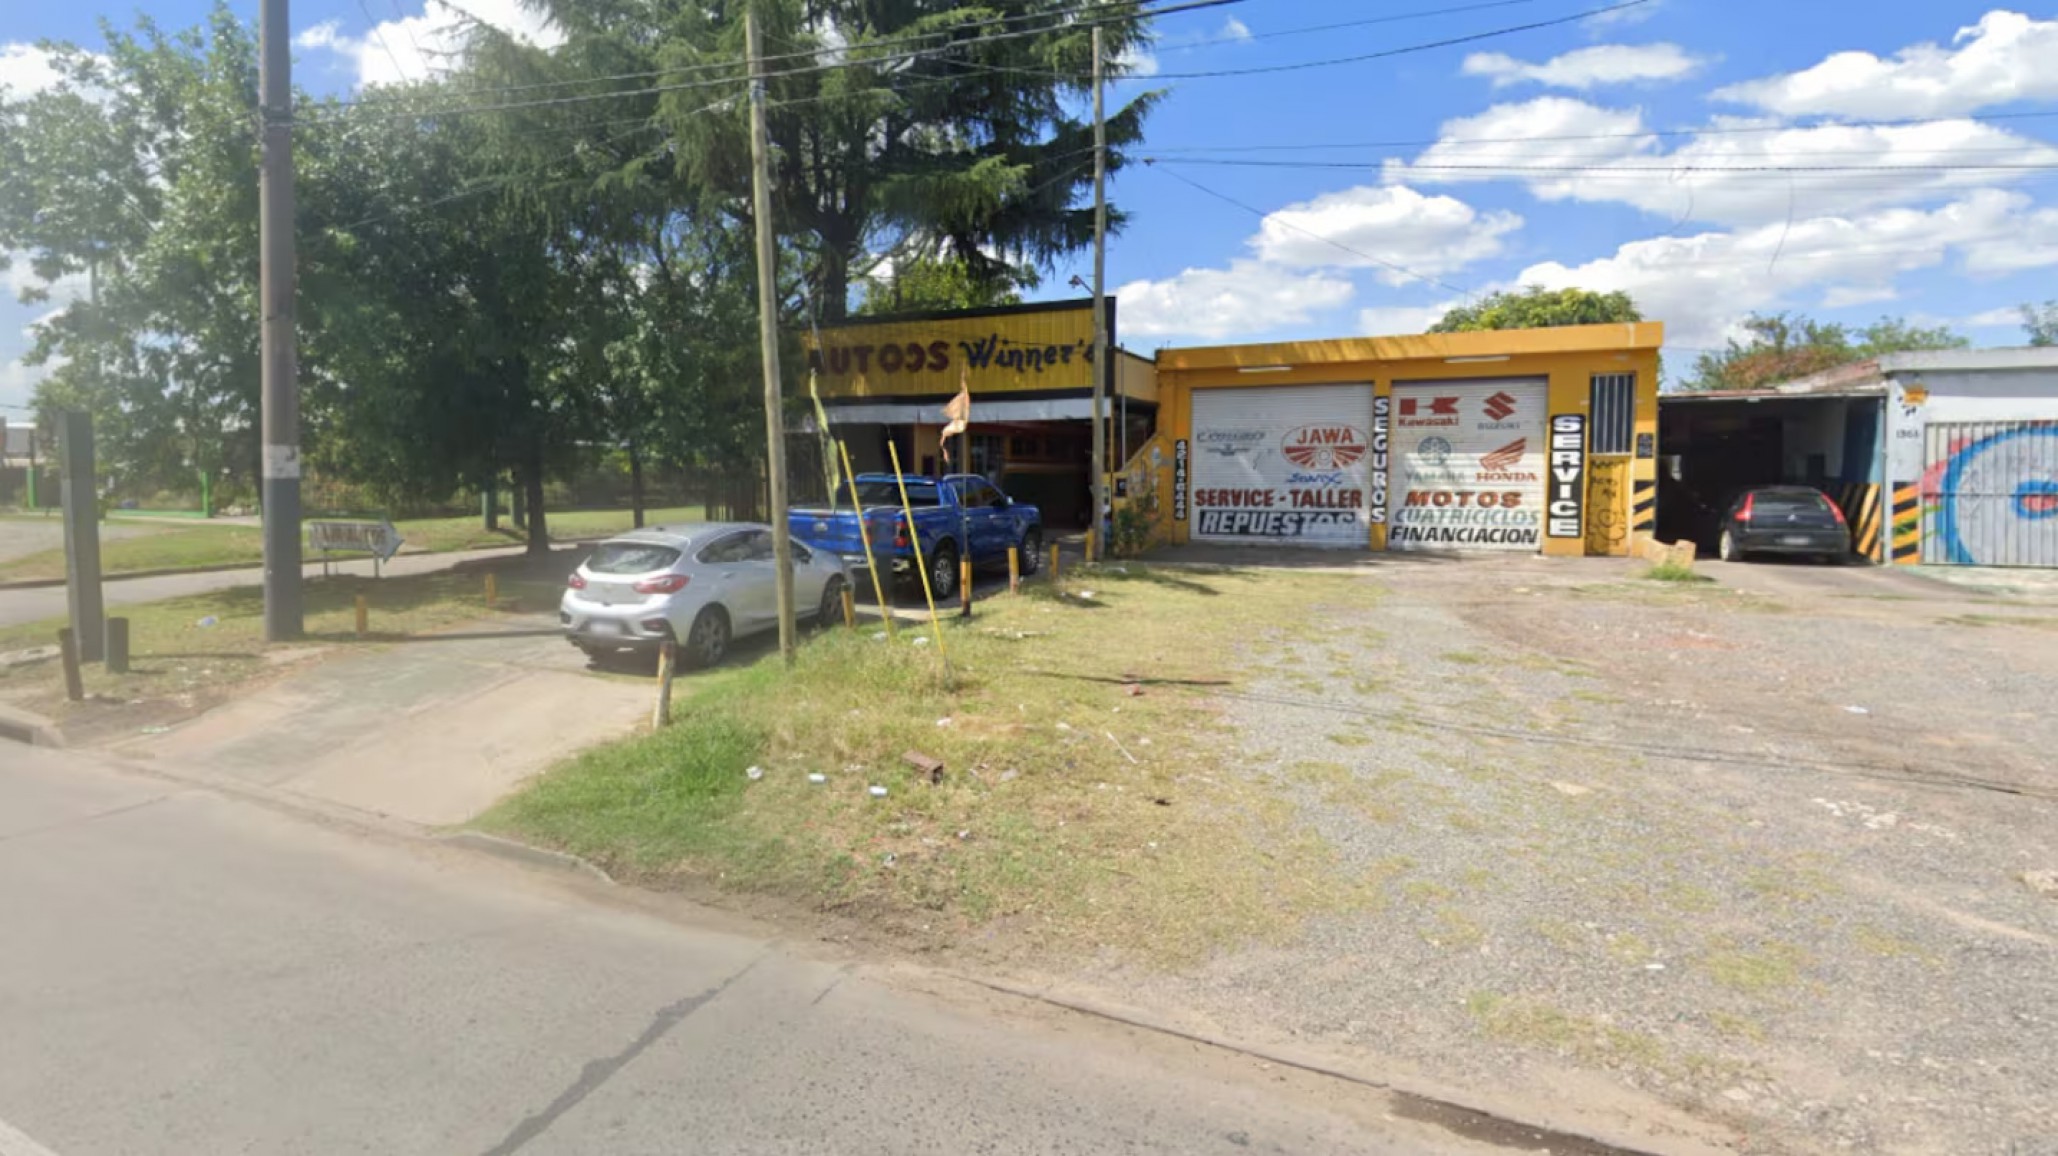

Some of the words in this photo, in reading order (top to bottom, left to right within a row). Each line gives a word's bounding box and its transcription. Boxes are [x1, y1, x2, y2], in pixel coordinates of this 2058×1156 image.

[1398, 416, 1459, 427] Kawasaki
[1296, 428, 1354, 444] JAWA
[1371, 398, 1389, 522] SEGUROS
[1476, 472, 1537, 482] HONDA
[1551, 416, 1583, 537] SERVICE
[1194, 488, 1275, 508] SERVICE
[1289, 488, 1363, 508] TALLER
[1405, 490, 1522, 508] MOTOS
[1395, 508, 1541, 526] CUATRICICLOS
[1390, 525, 1539, 544] FINANCIACION
